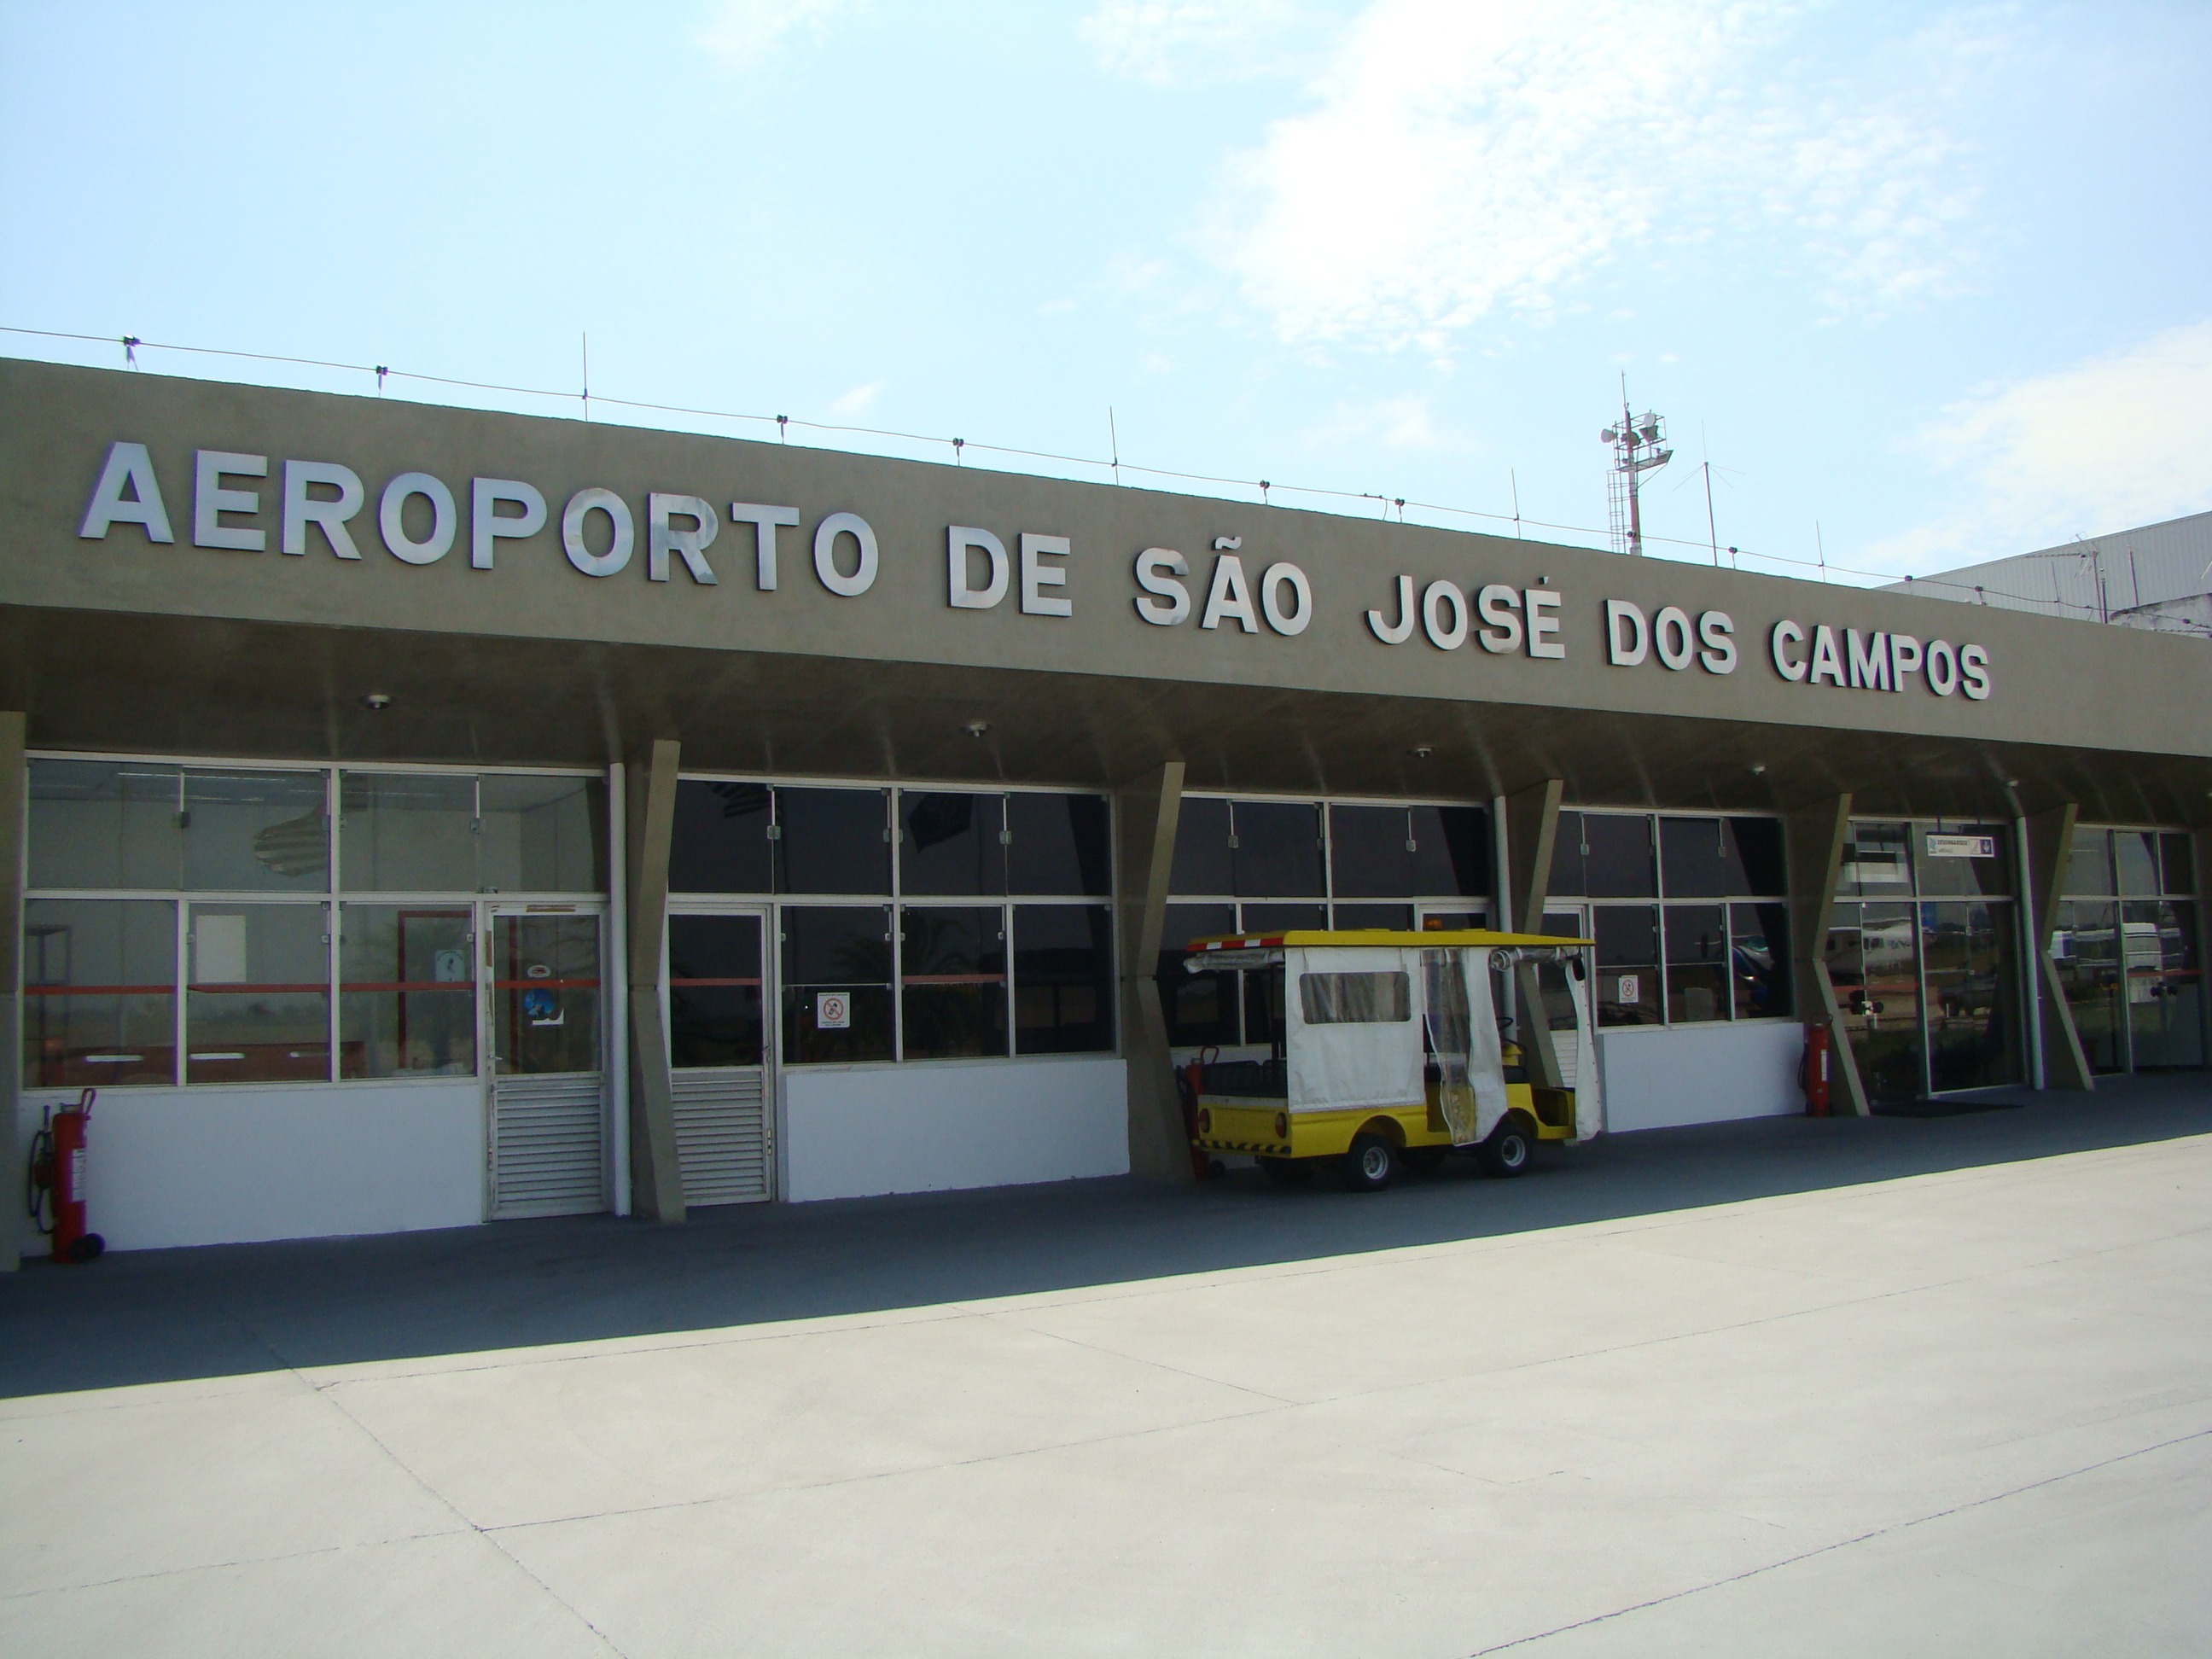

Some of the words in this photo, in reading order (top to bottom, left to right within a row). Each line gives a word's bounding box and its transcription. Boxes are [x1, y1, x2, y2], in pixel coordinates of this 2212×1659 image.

[79, 441, 879, 596] AEROPORTO
[946, 525, 1073, 616] DE
[1133, 536, 1313, 636] SÃO
[1366, 574, 1565, 660] JOSÉ
[1605, 599, 1738, 674] DOS
[1773, 620, 1990, 701] CAMPOS
